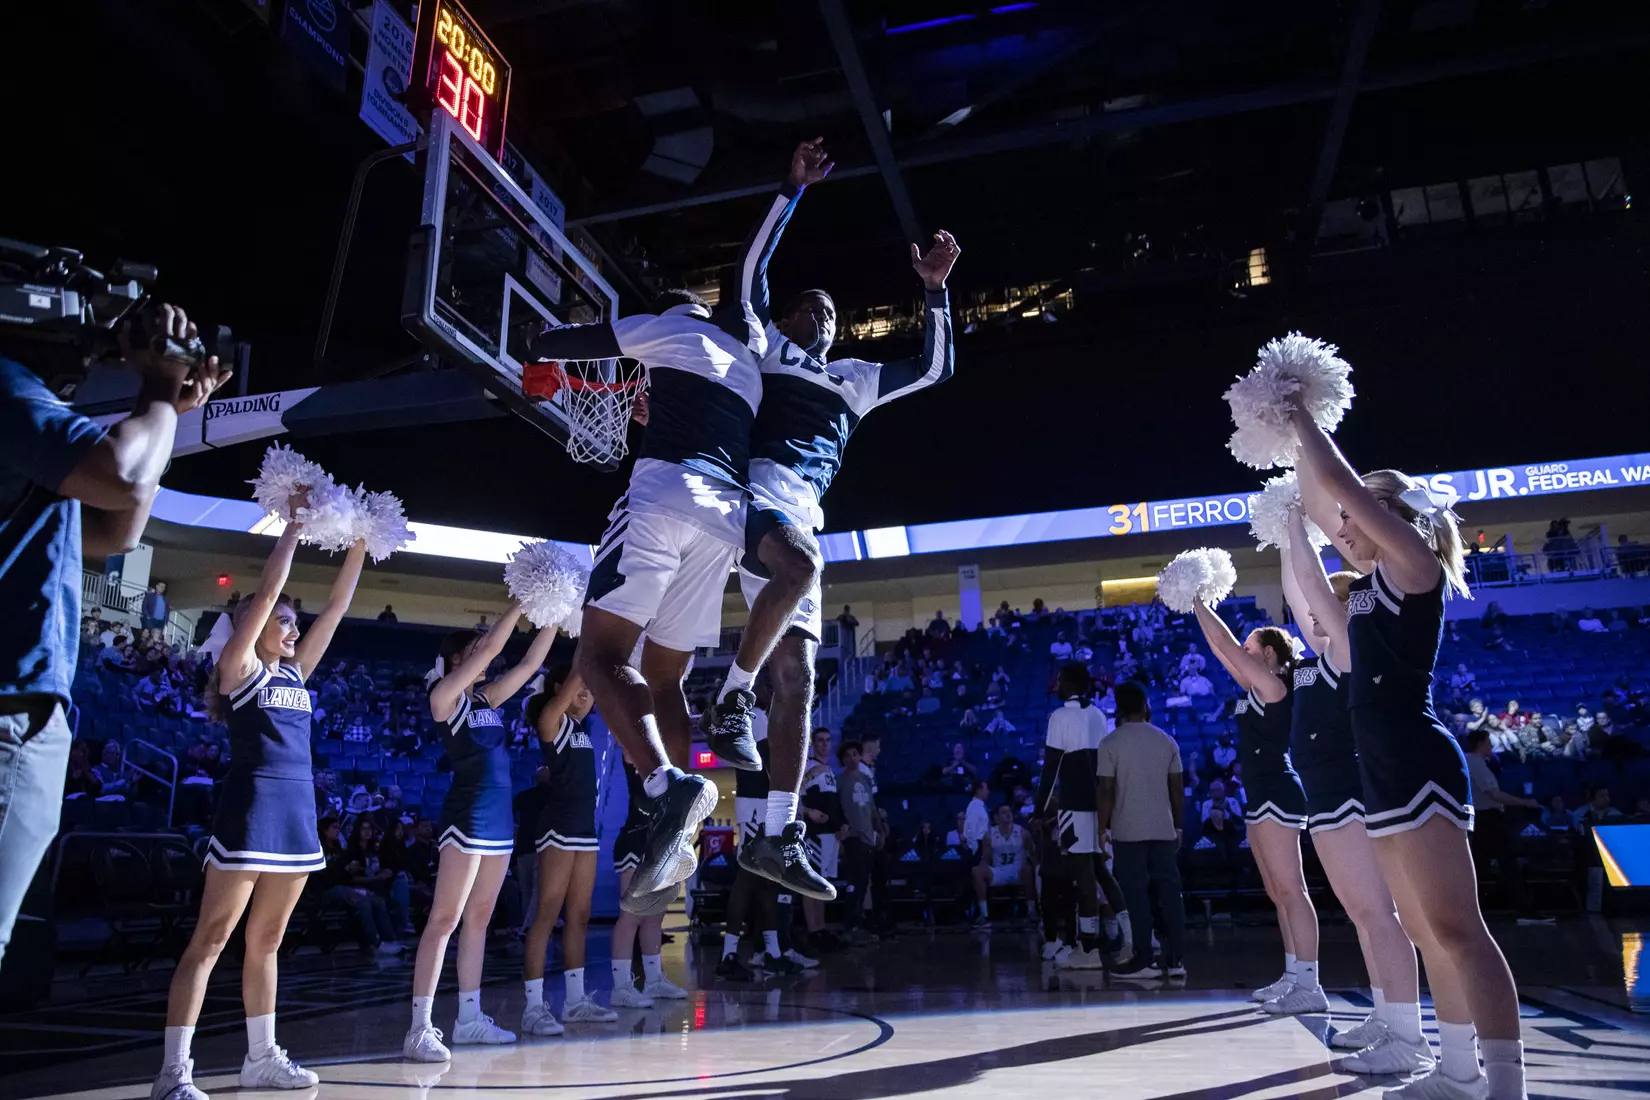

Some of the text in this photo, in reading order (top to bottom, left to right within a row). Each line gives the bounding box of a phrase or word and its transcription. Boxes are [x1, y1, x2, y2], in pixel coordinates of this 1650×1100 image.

[290, 6, 344, 66] CHAMPIONS
[384, 16, 413, 54] 2016
[437, 8, 495, 95] 20:00
[437, 50, 484, 141] 30
[539, 191, 558, 217] 2017
[206, 393, 281, 420] SPALDING
[1525, 463, 1569, 477] GUARD
[1528, 469, 1619, 492] FEDERAL
[1107, 502, 1149, 535] 31
[1153, 498, 1253, 528] FERRO
[1468, 468, 1529, 501] JR.
